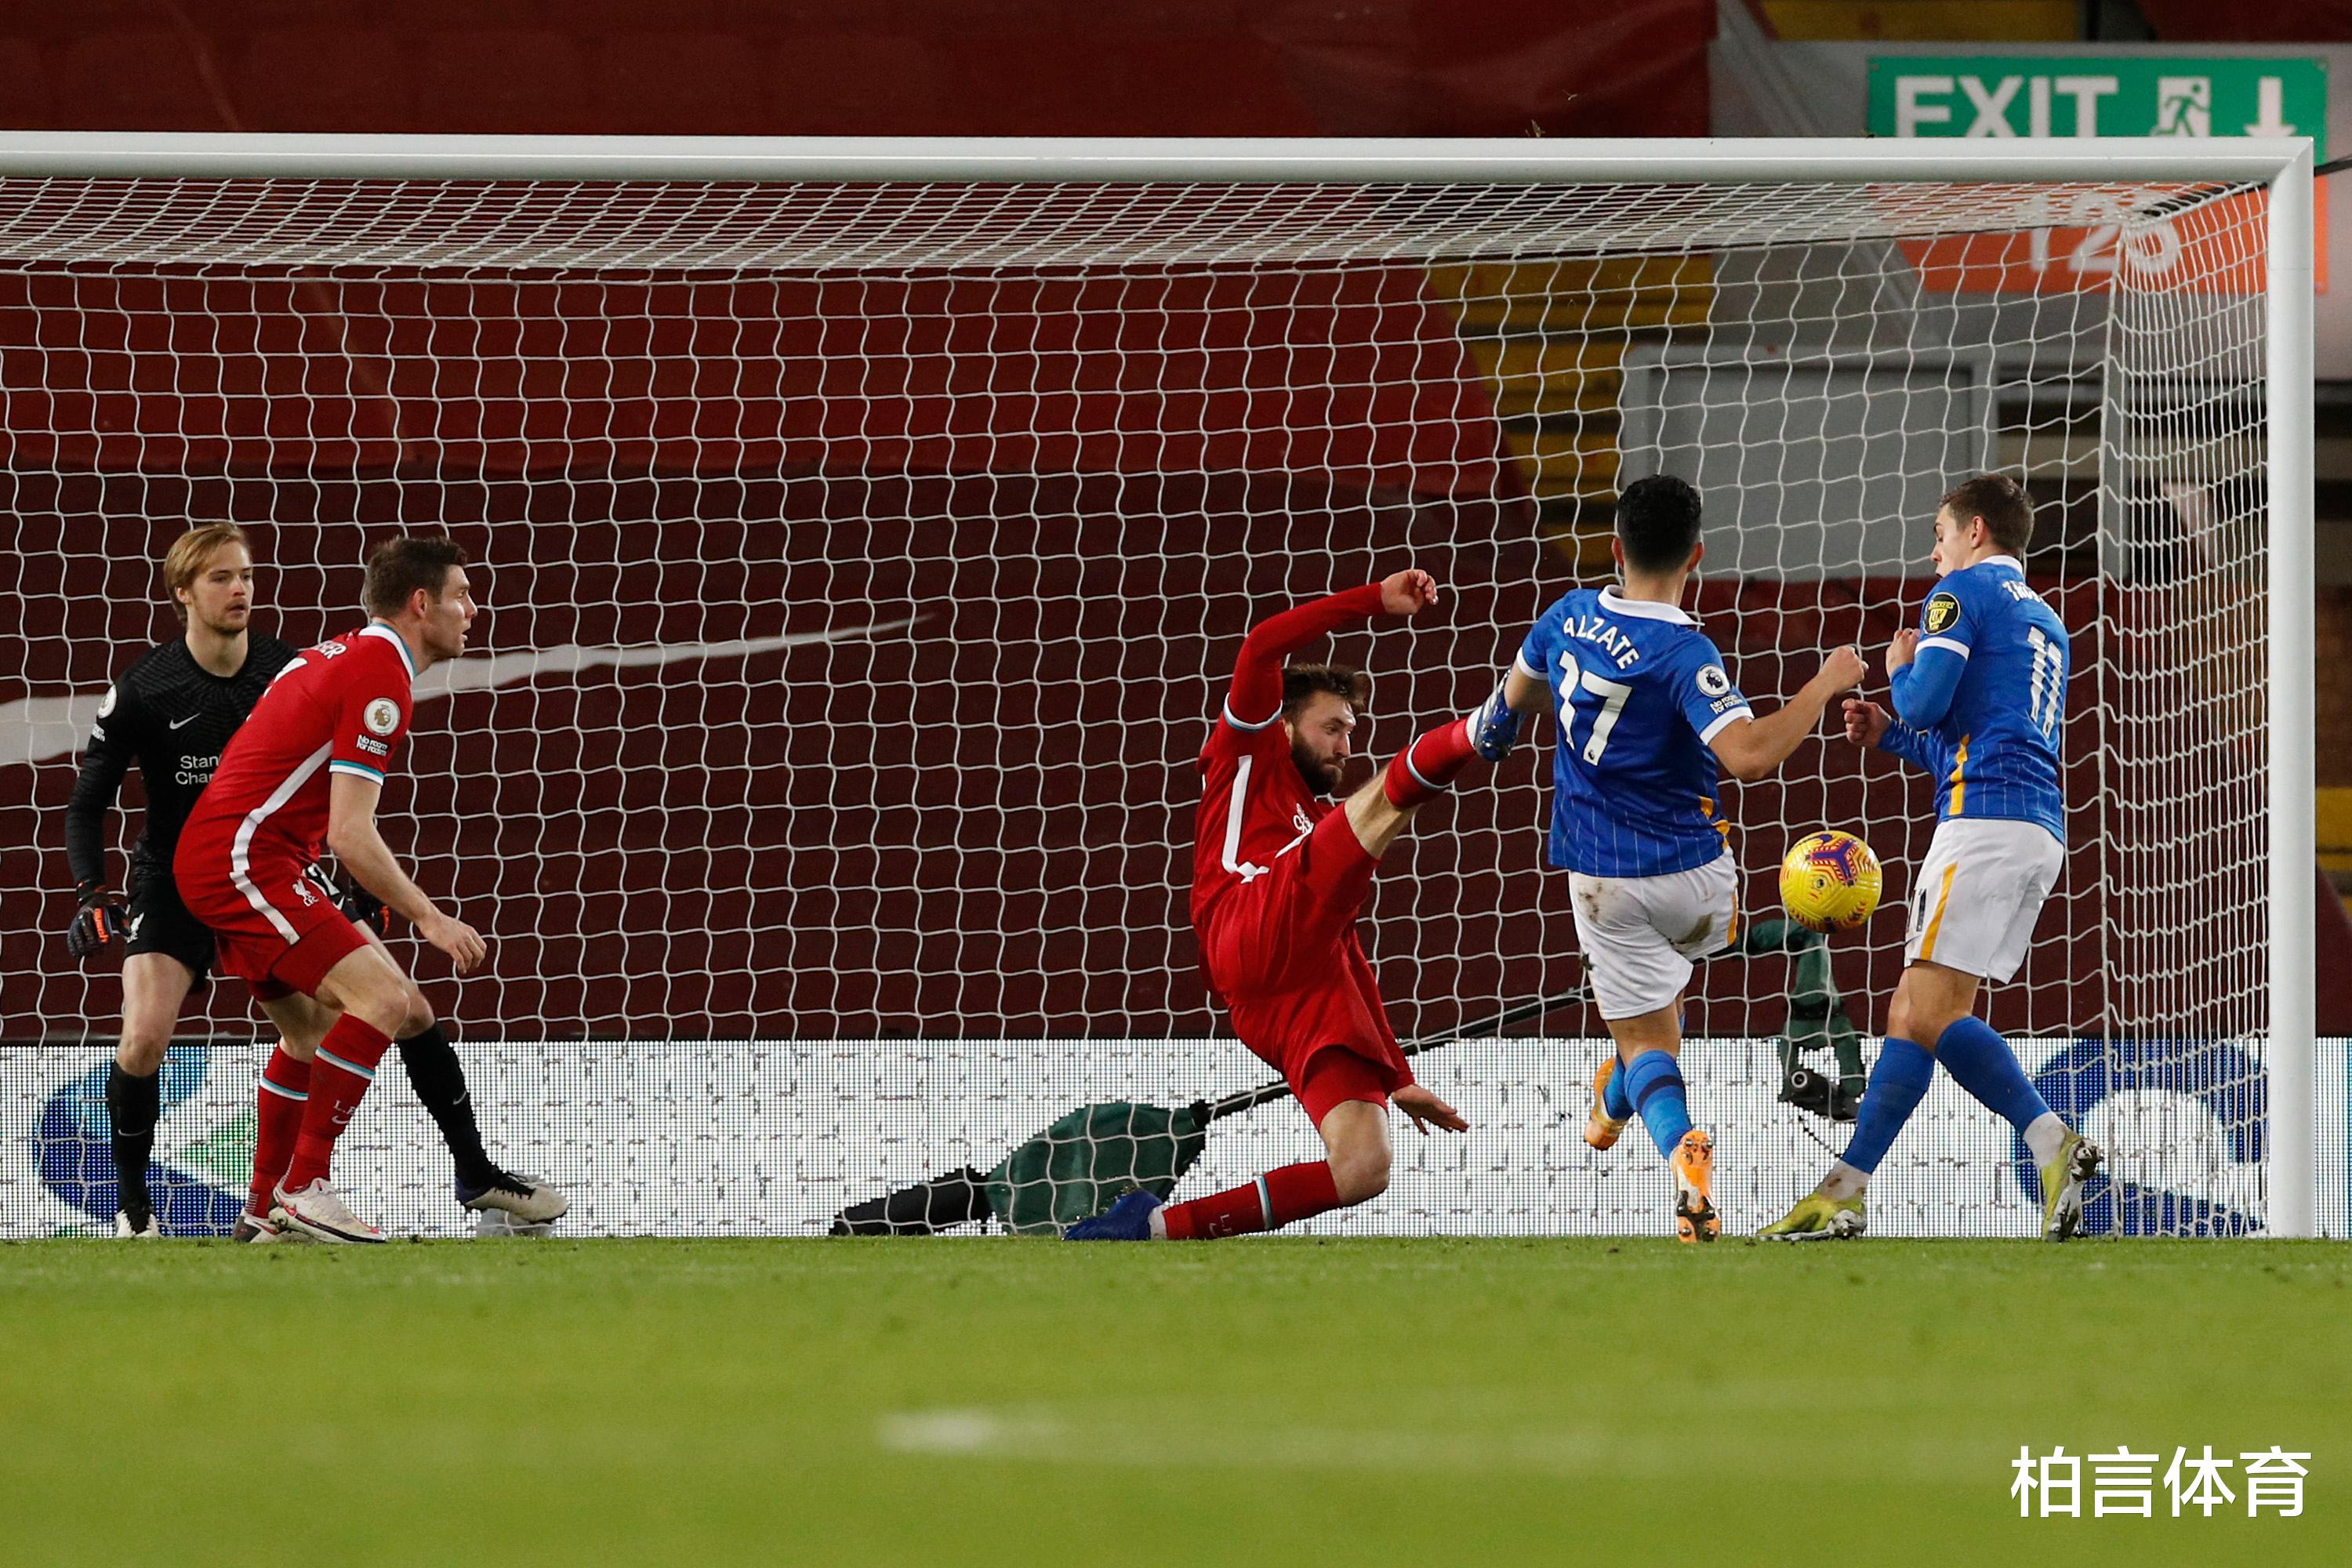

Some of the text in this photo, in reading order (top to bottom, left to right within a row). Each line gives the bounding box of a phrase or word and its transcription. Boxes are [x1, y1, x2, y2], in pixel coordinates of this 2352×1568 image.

[1895, 76, 2118, 137] EXIT
[1563, 615, 1640, 670] ALZATE
[1559, 657, 1633, 767] 17
[2027, 626, 2063, 739] 11
[180, 754, 223, 769] Stan
